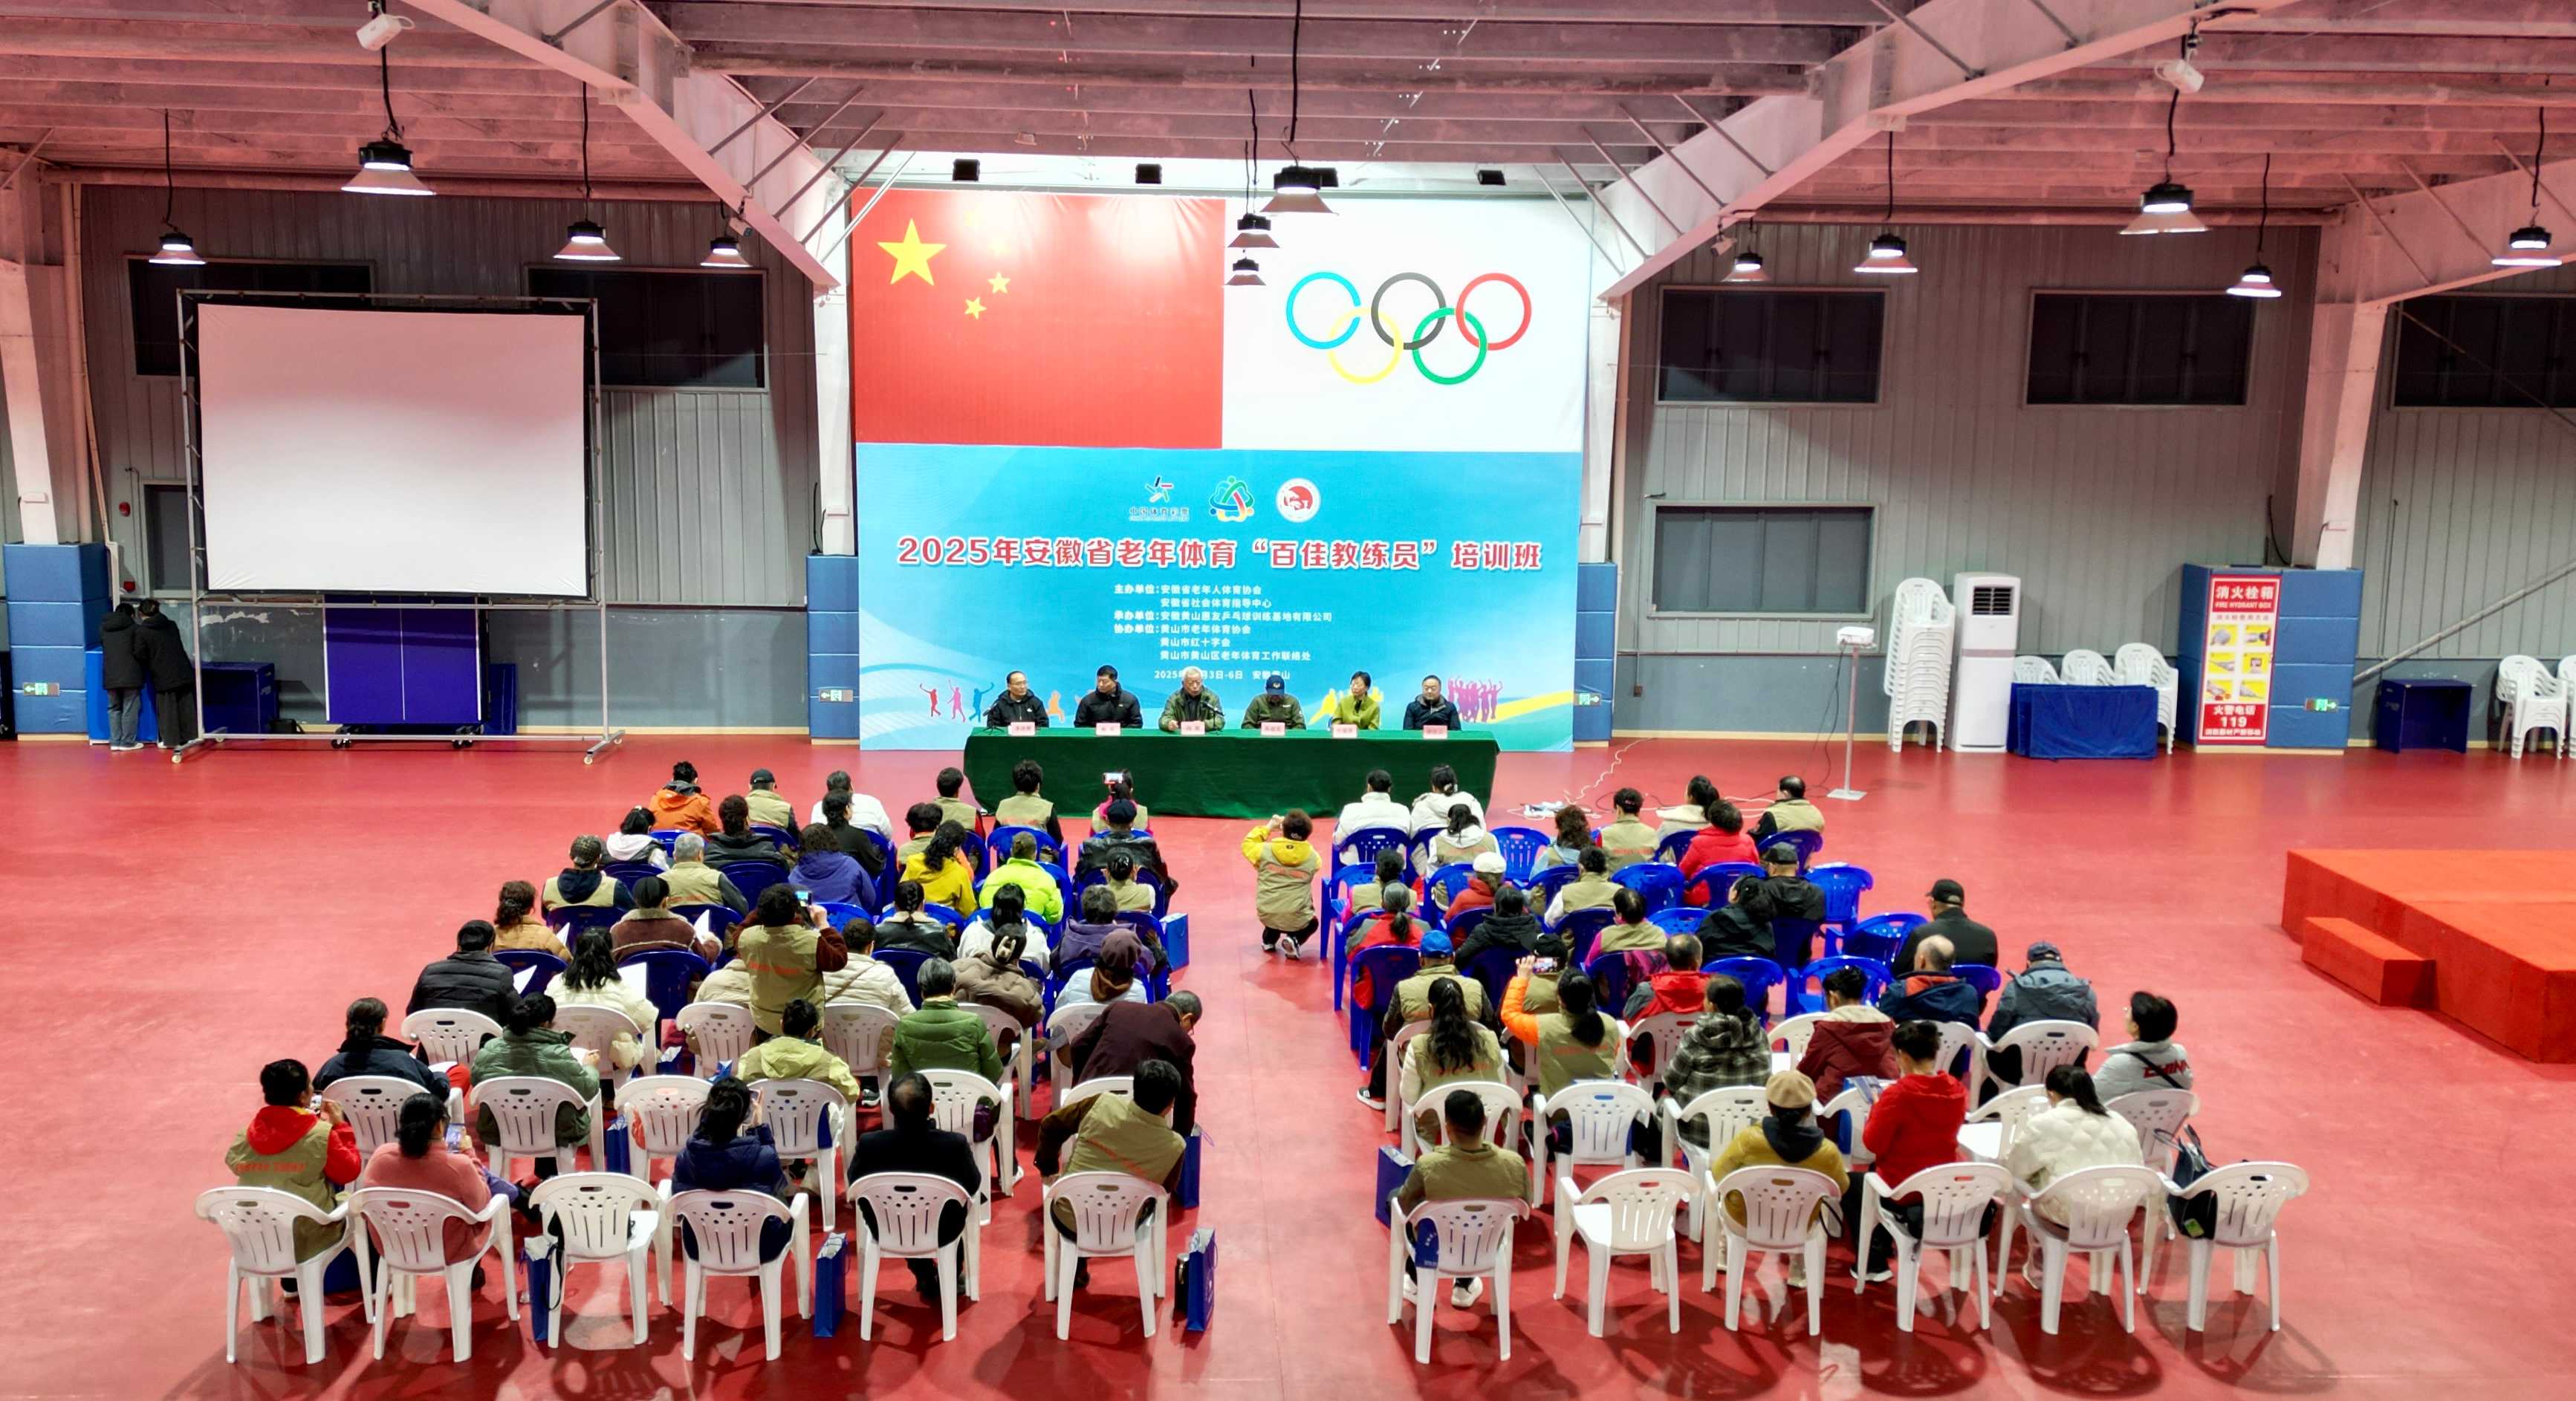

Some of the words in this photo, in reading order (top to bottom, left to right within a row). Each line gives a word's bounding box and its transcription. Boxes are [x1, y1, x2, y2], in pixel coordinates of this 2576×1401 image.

[2216, 585, 2274, 599] 消火栓箱
[2213, 705, 2256, 715] 火警电话
[2220, 716, 2247, 727] 119
